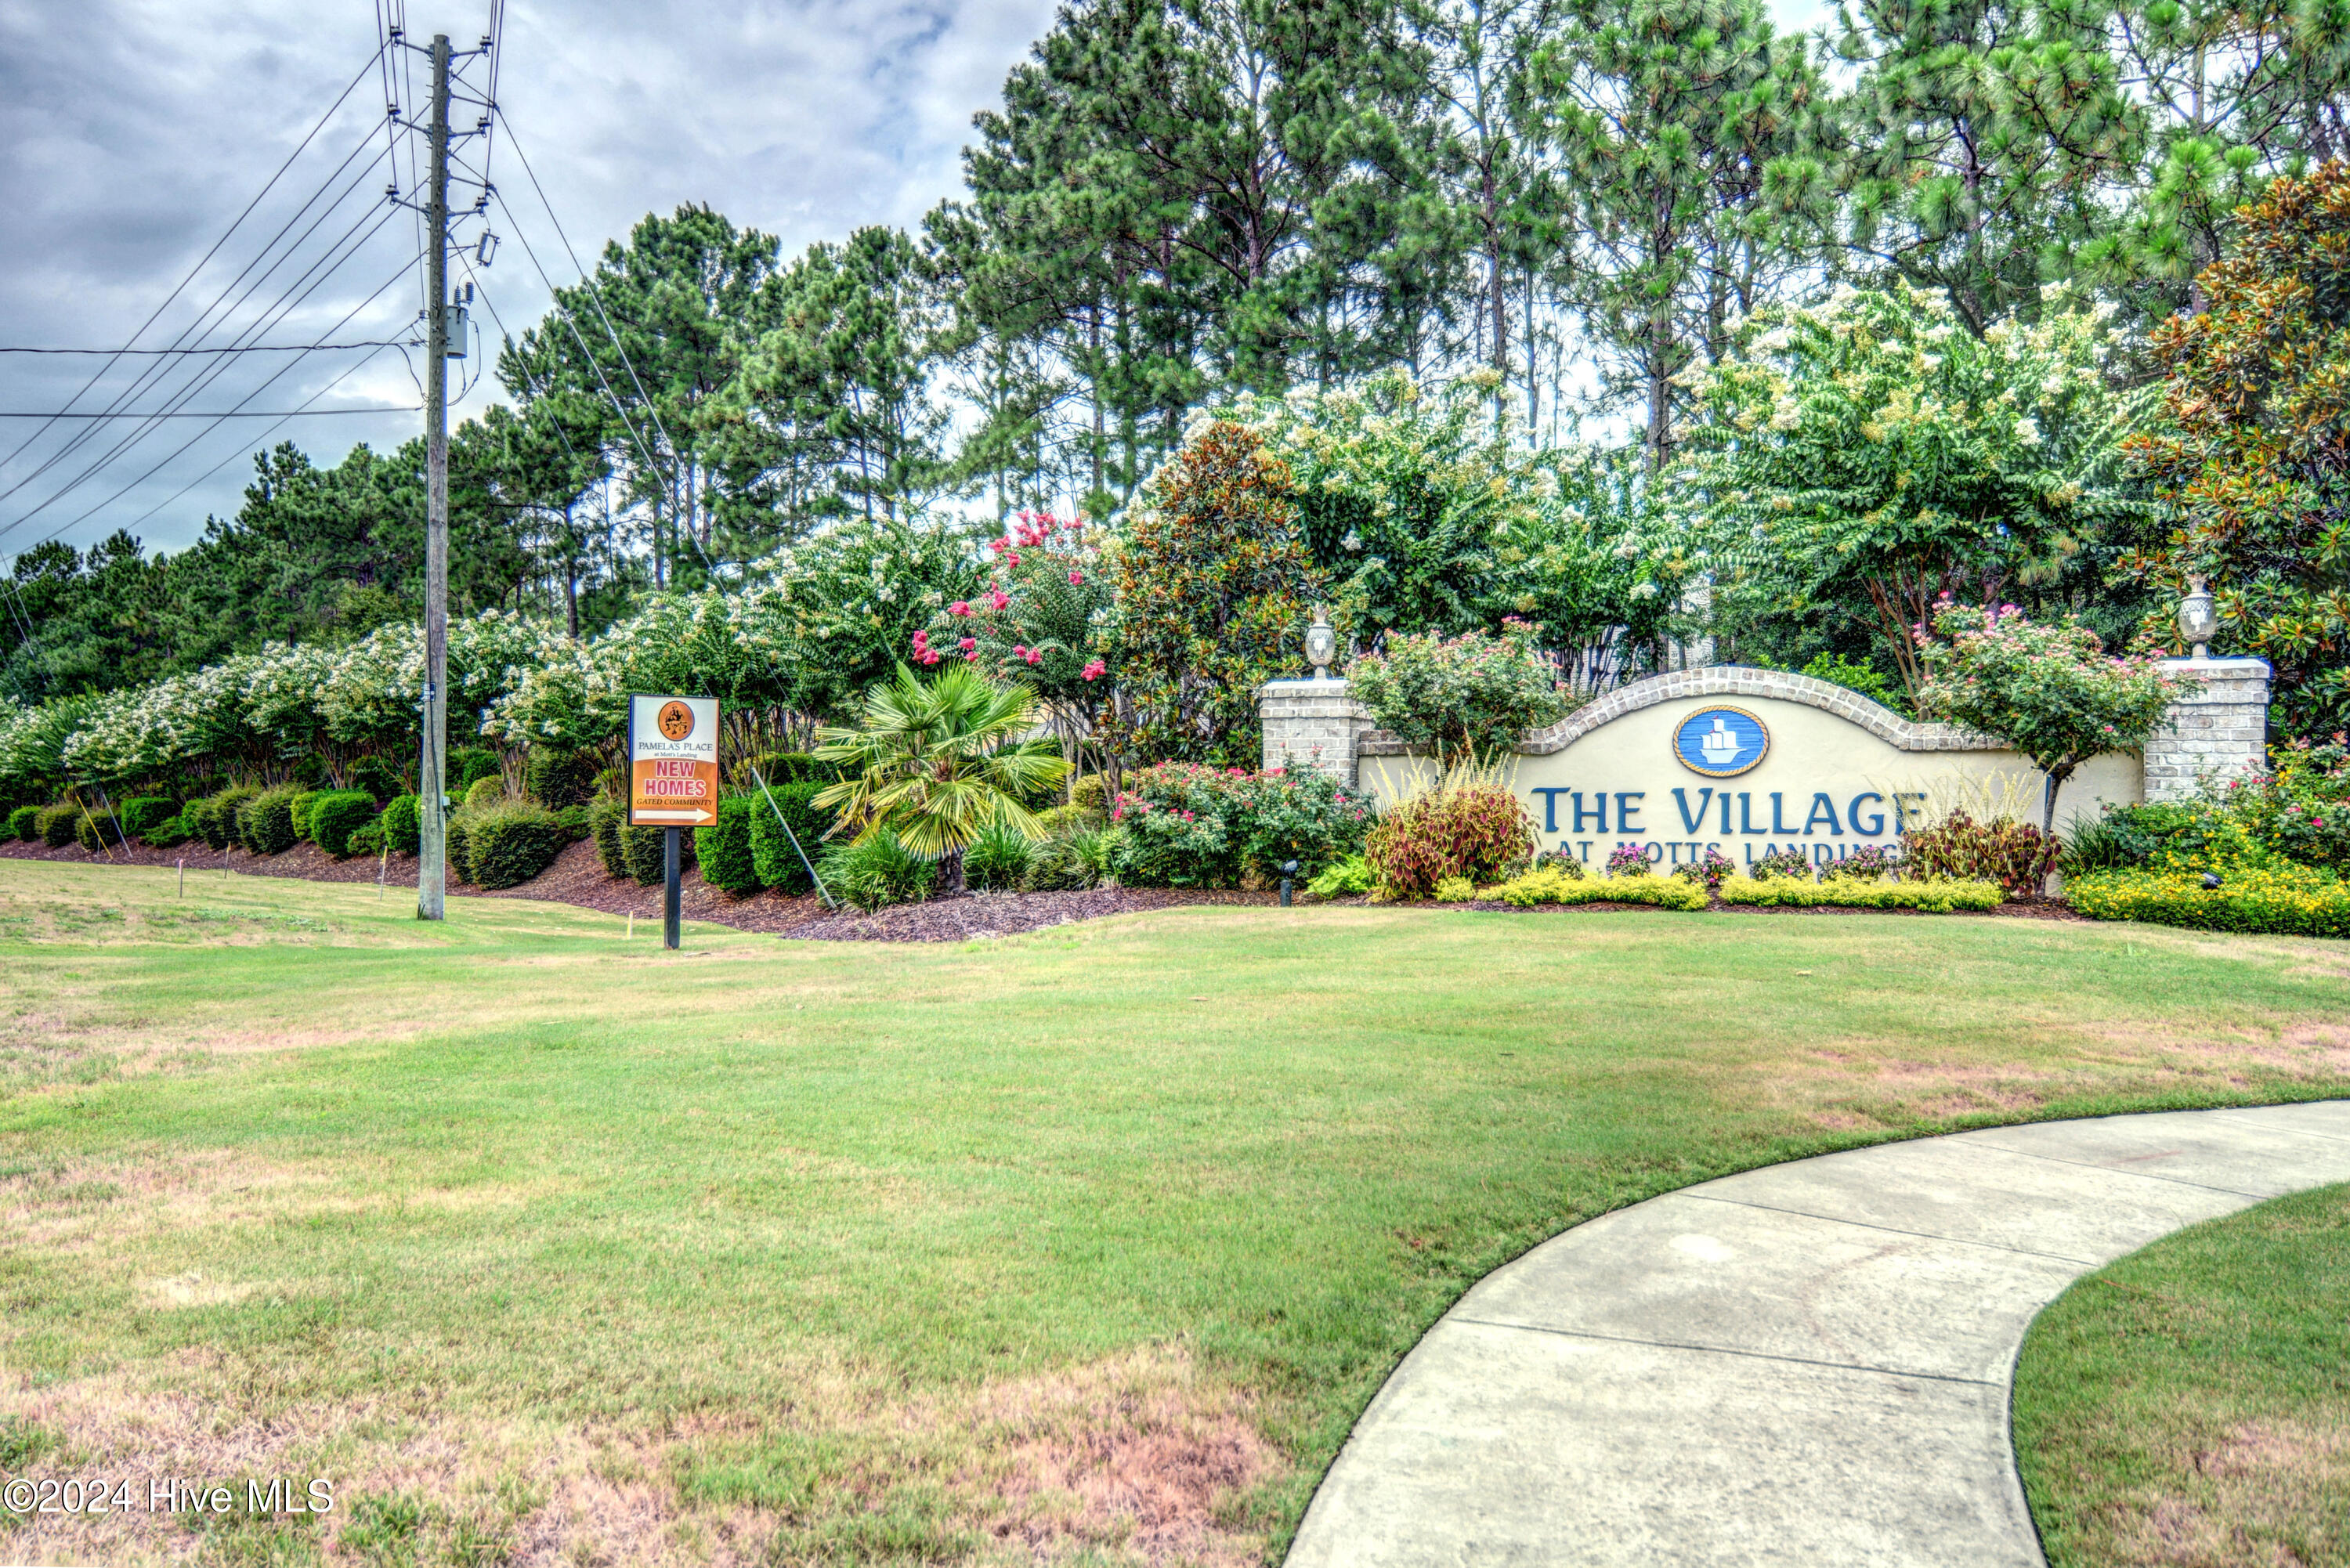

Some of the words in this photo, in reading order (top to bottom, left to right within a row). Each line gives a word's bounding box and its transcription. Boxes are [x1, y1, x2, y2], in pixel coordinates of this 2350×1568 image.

[656, 761, 696, 777] NEW
[645, 779, 707, 797] HOMES
[1531, 786, 1647, 833] THE
[1671, 787, 1927, 836] VILLAGE
[1559, 840, 1594, 862] AT
[1616, 840, 1721, 865] OTT
[1744, 843, 1899, 865] LANDIG
